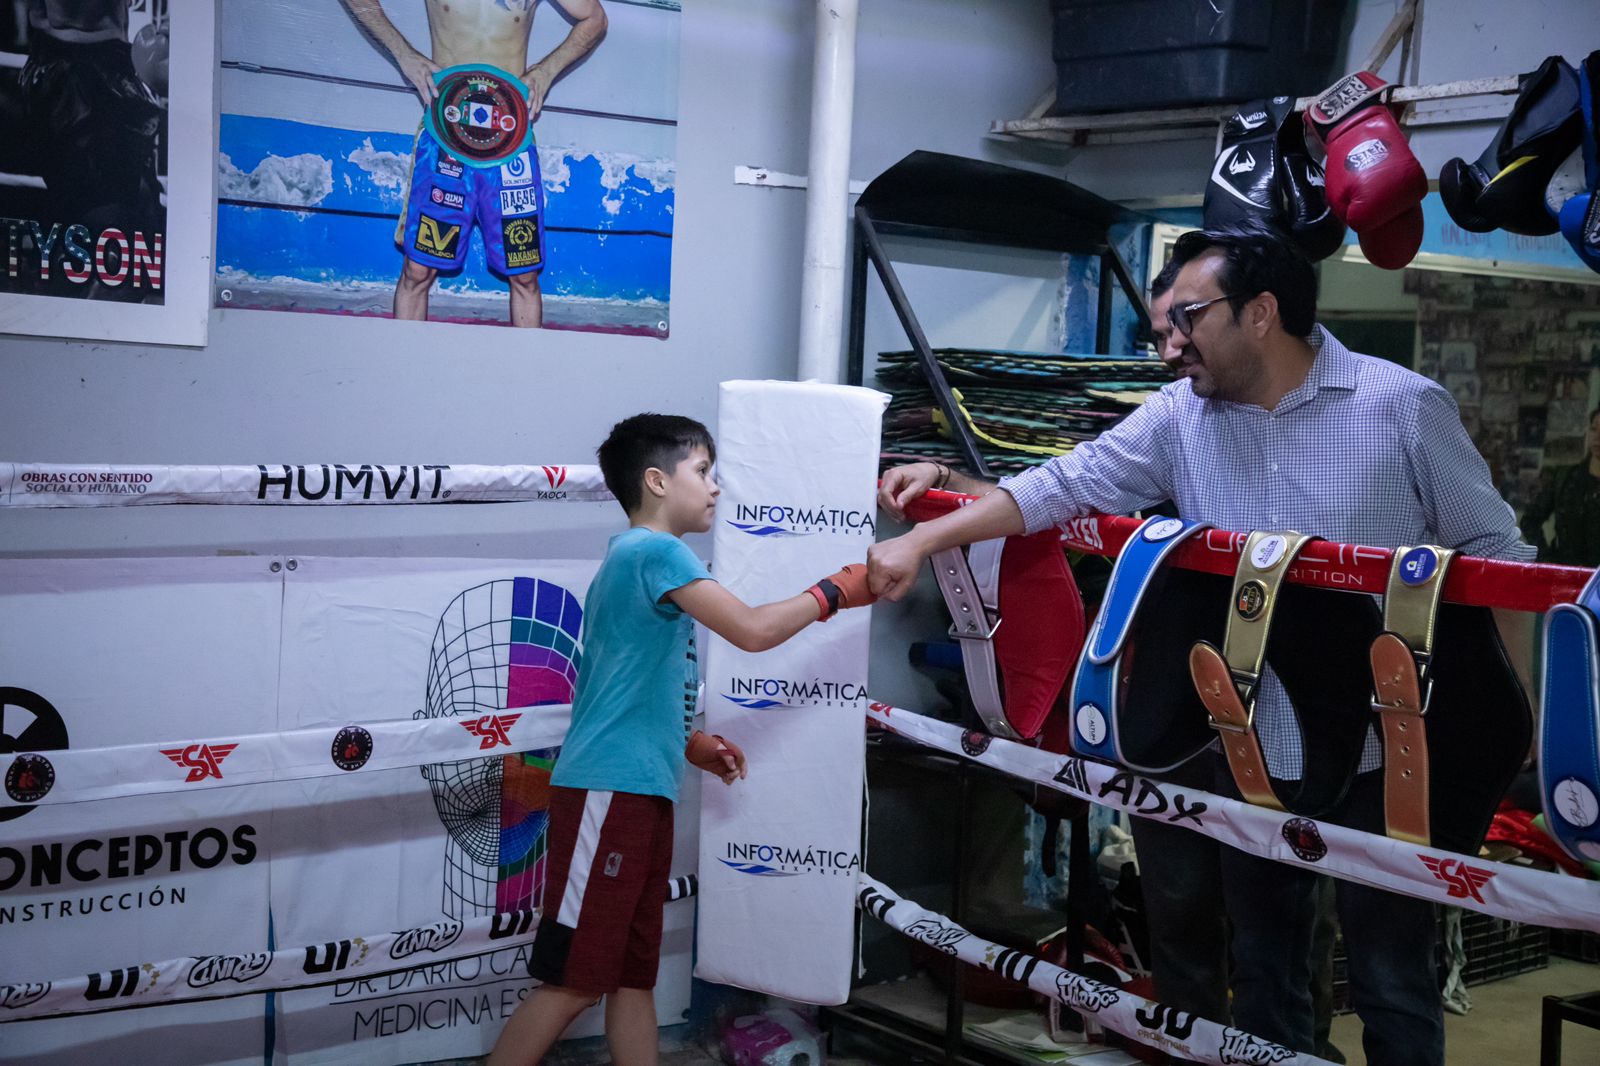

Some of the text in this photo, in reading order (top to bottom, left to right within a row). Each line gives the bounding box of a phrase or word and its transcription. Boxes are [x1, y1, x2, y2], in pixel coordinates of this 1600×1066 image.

[1320, 76, 1367, 116] REYS
[1349, 139, 1389, 168] REYES
[417, 214, 460, 251] EV
[0, 218, 162, 290] TYSON
[21, 472, 153, 483] OBRAS CON SENTIDO
[25, 483, 147, 494] SOCIAL Y HUMANO
[257, 464, 451, 500] HUMVIT
[536, 491, 567, 500] YAOCA
[737, 503, 875, 530] INFORMÁTICA
[731, 677, 867, 700] INFORMÁTICA
[1097, 771, 1208, 827] ADX
[0, 824, 257, 891] ONCEPTOS
[727, 842, 860, 869] INFORMÁTICA
[0, 885, 186, 924] NSTRUCCIÓN
[353, 993, 493, 1041] MEDICINA
